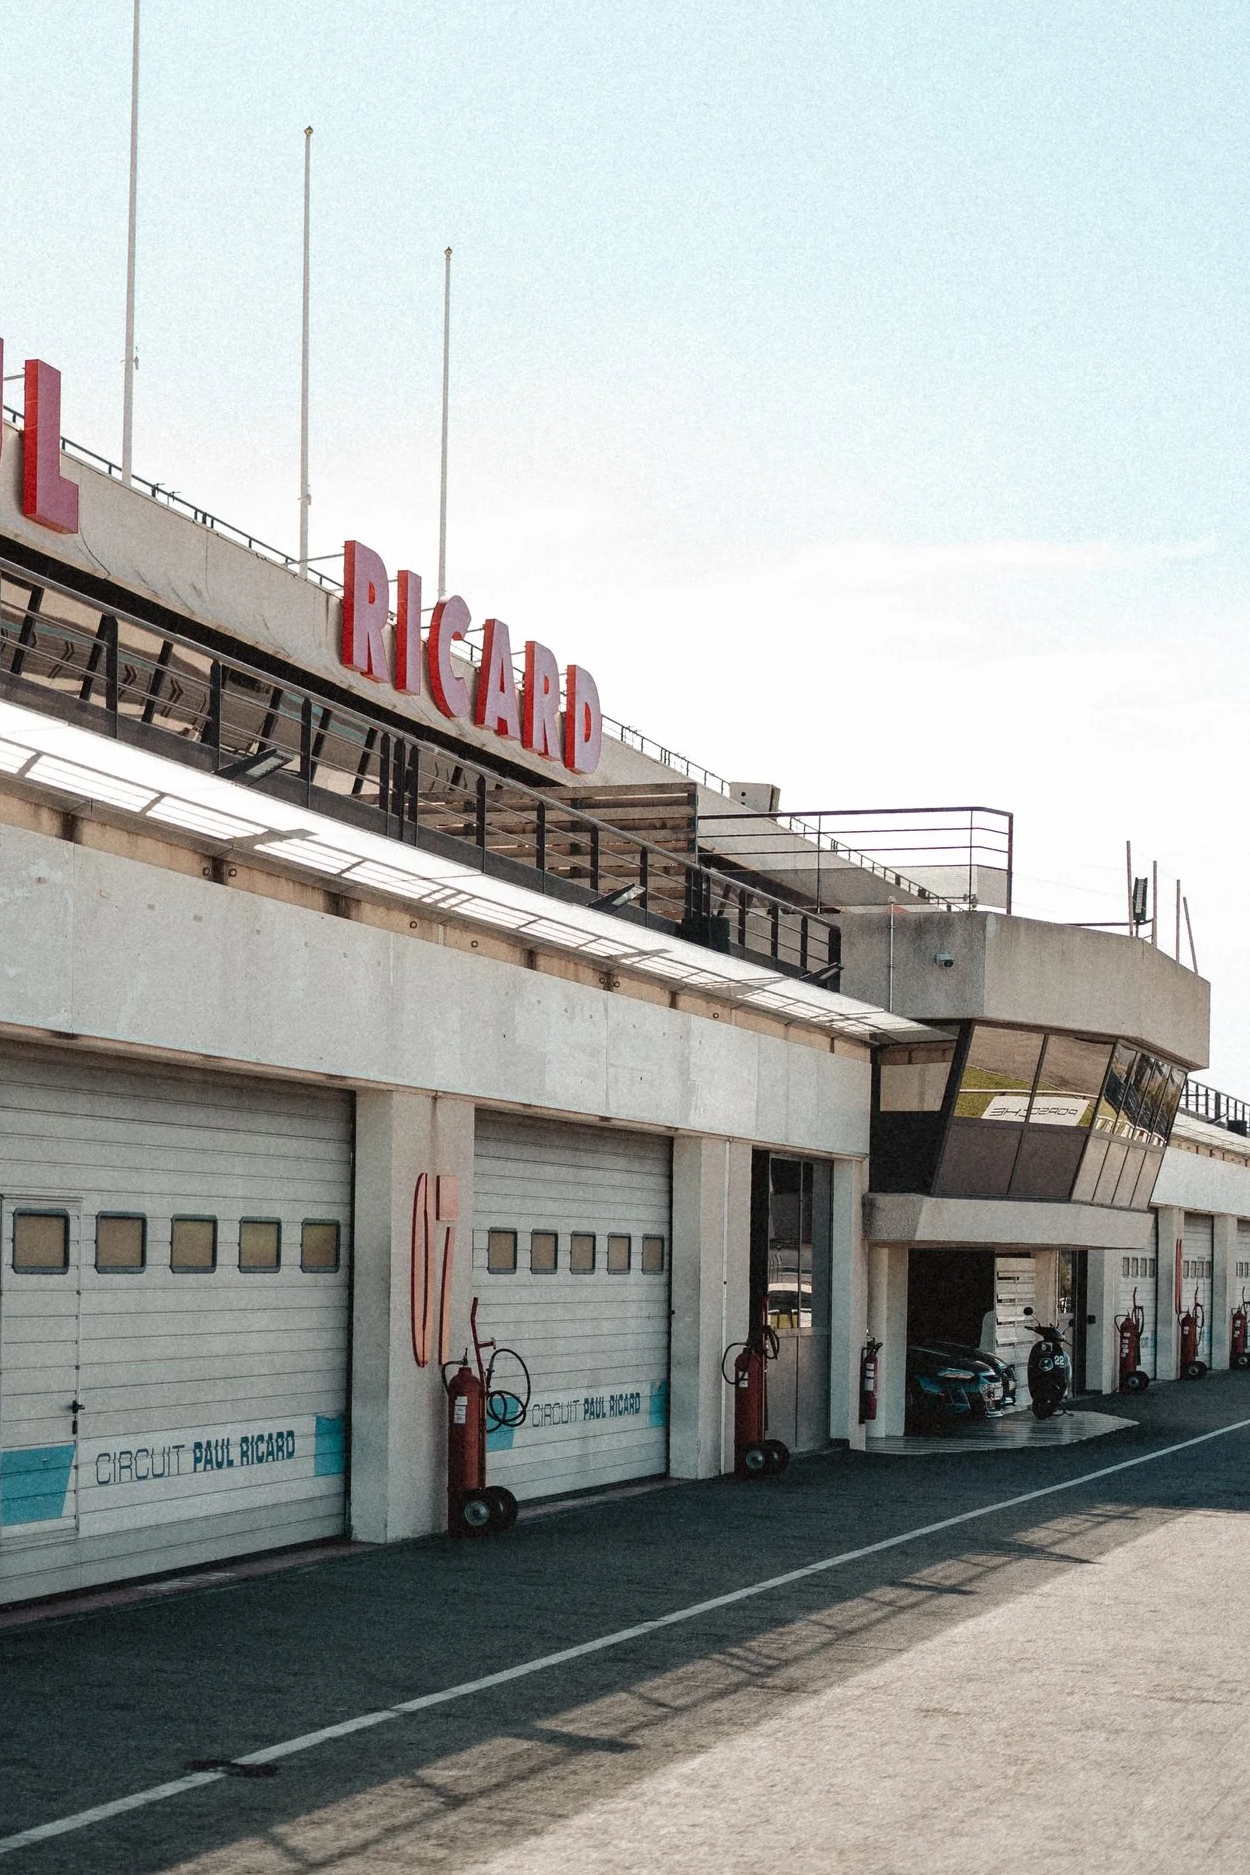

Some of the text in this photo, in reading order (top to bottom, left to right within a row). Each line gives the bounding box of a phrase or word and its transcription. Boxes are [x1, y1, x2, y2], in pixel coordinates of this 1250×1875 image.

[341, 540, 602, 775] RICARD
[1054, 1355, 1065, 1365] 22
[532, 1392, 641, 1427] CIRCUIT PAUL RICARD
[95, 1430, 296, 1485] CIRCUIT PAUL RICARD
